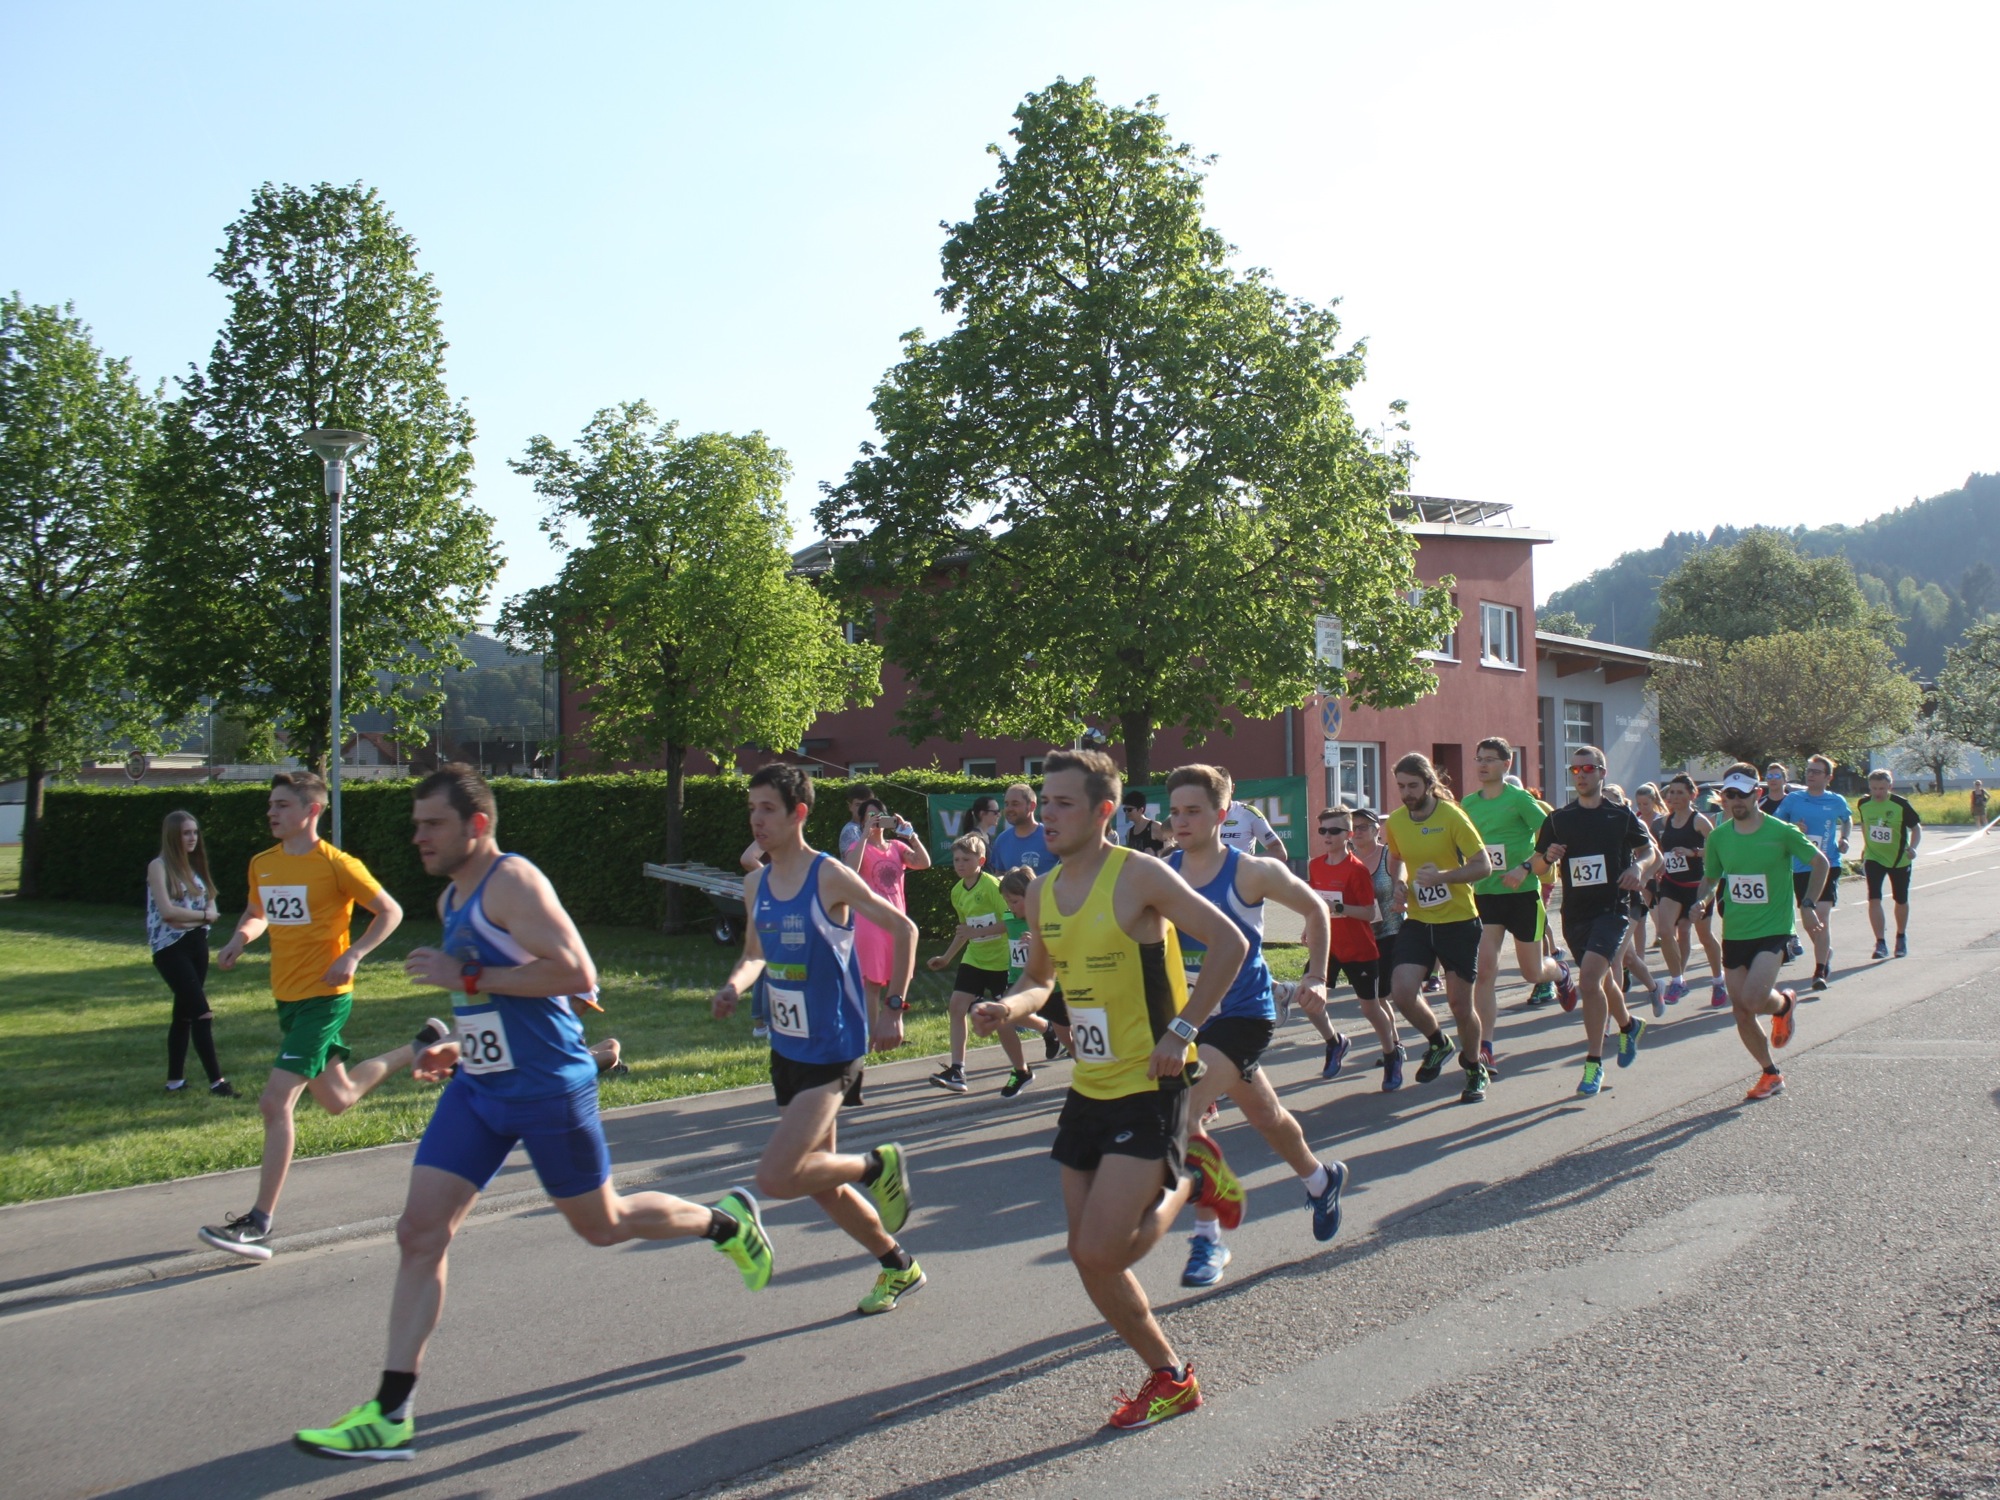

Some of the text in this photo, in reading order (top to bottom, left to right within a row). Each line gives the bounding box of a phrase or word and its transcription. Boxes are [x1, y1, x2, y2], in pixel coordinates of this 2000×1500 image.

[1870, 830, 1891, 841] 438
[1573, 863, 1603, 882] 437
[1665, 856, 1686, 870] 432
[1418, 883, 1447, 903] 426
[1731, 882, 1765, 899] 436
[266, 897, 304, 919] 423
[1012, 947, 1029, 963] 41
[462, 1030, 502, 1064] 28
[1076, 1024, 1105, 1056] 29
